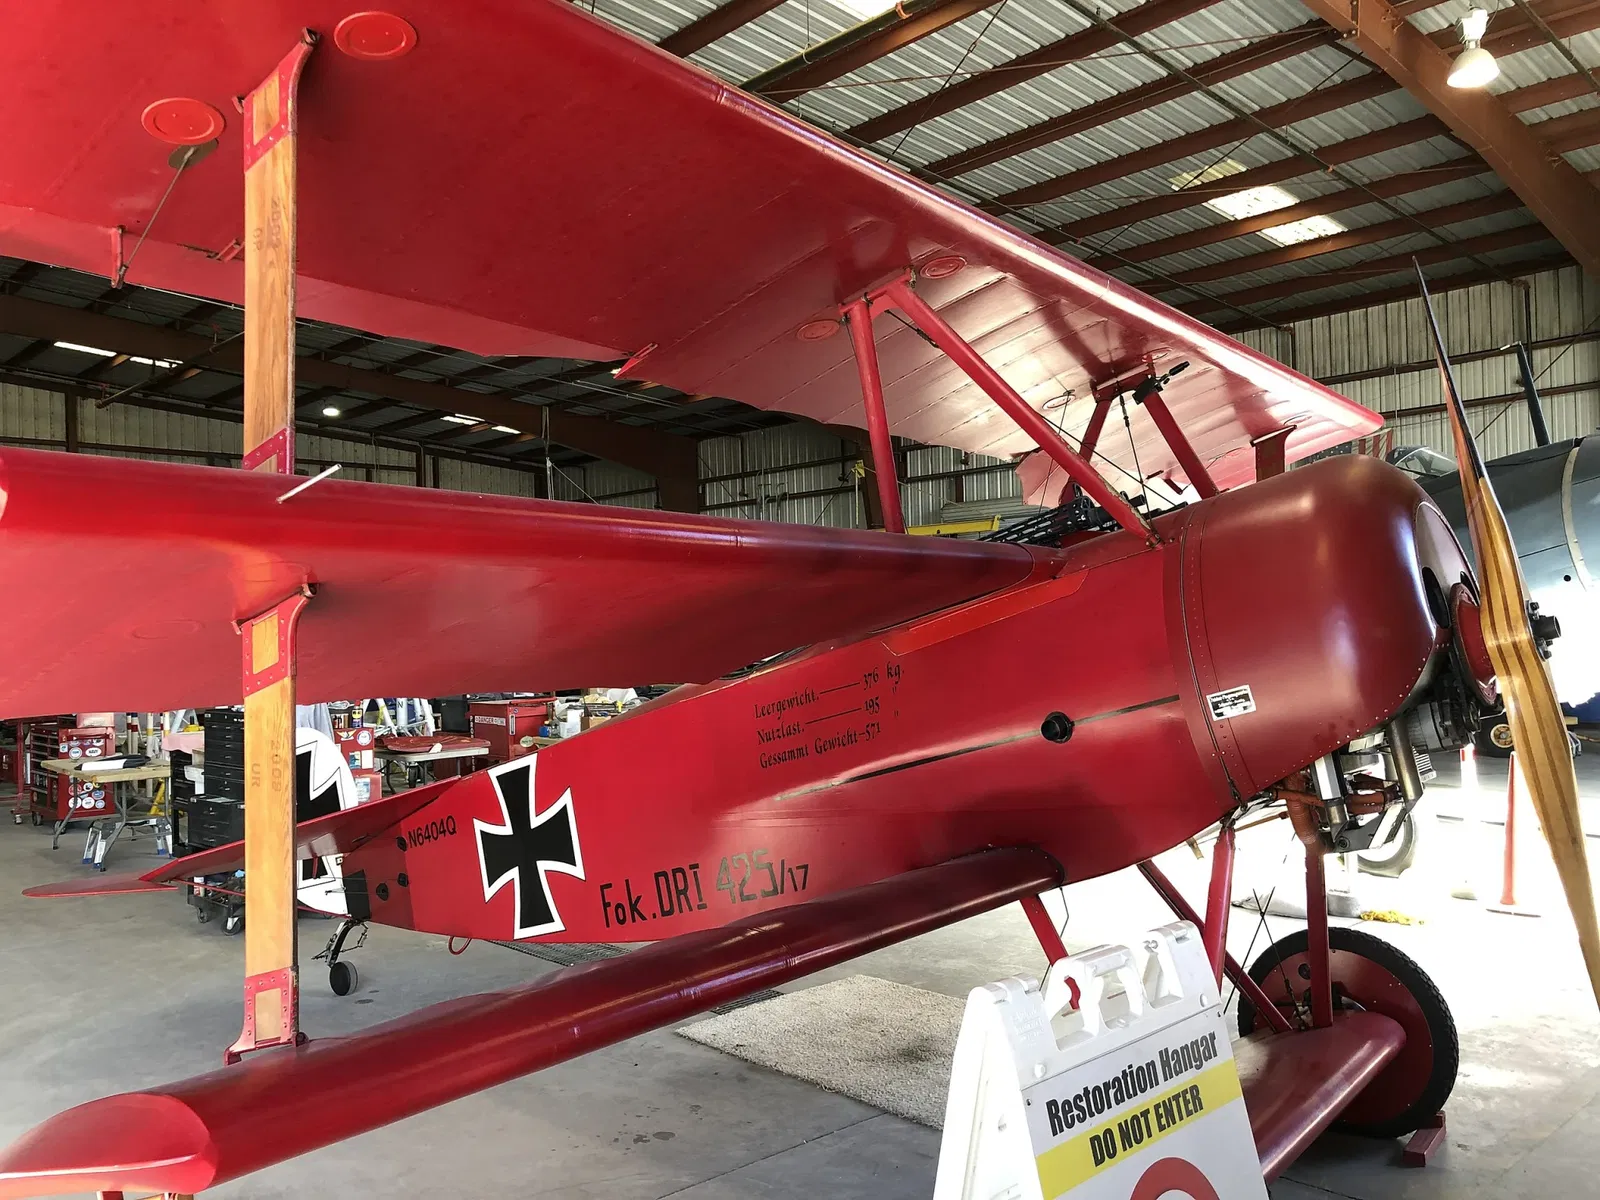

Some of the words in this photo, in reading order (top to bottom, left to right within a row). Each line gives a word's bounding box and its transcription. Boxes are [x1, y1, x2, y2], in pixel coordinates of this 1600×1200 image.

[863, 667, 879, 690] 376
[864, 696, 880, 716] 195
[759, 743, 809, 769] Gessammt
[408, 815, 457, 848] N6404Q
[715, 848, 809, 904] 425/17
[1046, 1064, 1160, 1137] Restoration
[1158, 1031, 1218, 1082] Hangar
[1089, 1127, 1117, 1168] DO
[1117, 1108, 1152, 1151] NOT
[1153, 1084, 1204, 1133] ENTER
